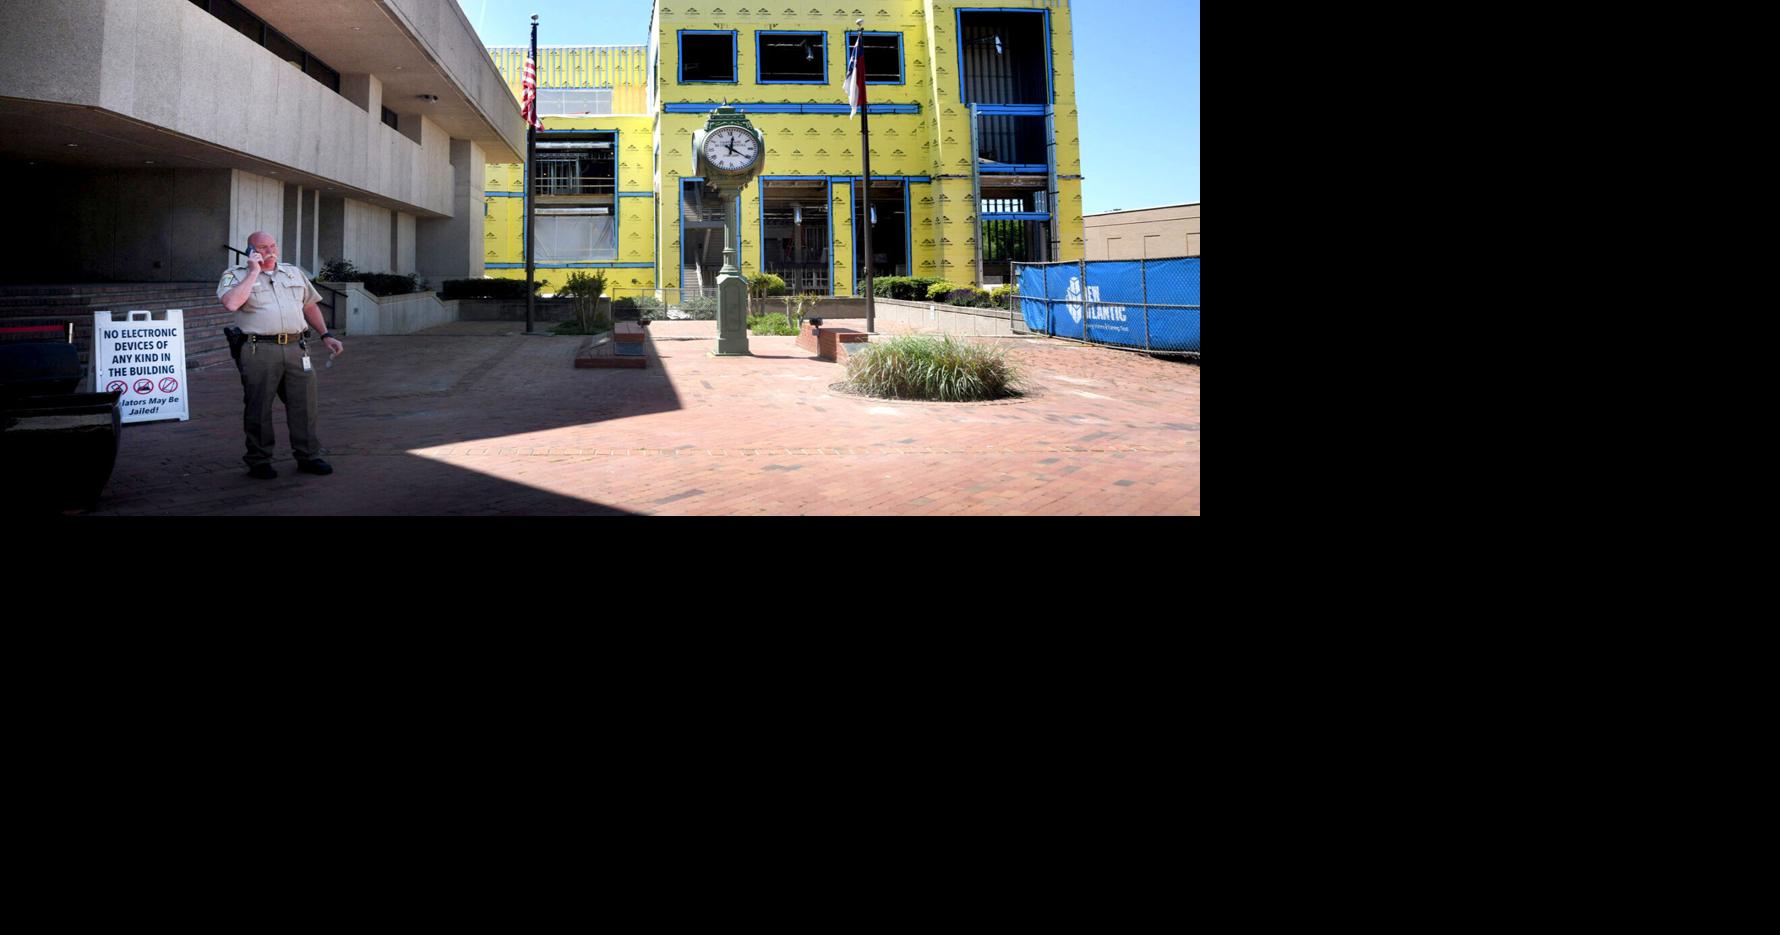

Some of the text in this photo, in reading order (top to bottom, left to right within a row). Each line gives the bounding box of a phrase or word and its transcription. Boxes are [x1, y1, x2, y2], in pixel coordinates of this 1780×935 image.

[104, 328, 177, 339] NO ELECTRONIC
[115, 340, 168, 351] DEVICES OF
[112, 353, 171, 364] ANY KIND IN
[108, 365, 175, 377] THE BUILDING
[148, 397, 167, 406] May
[129, 407, 159, 416] Jailed!
